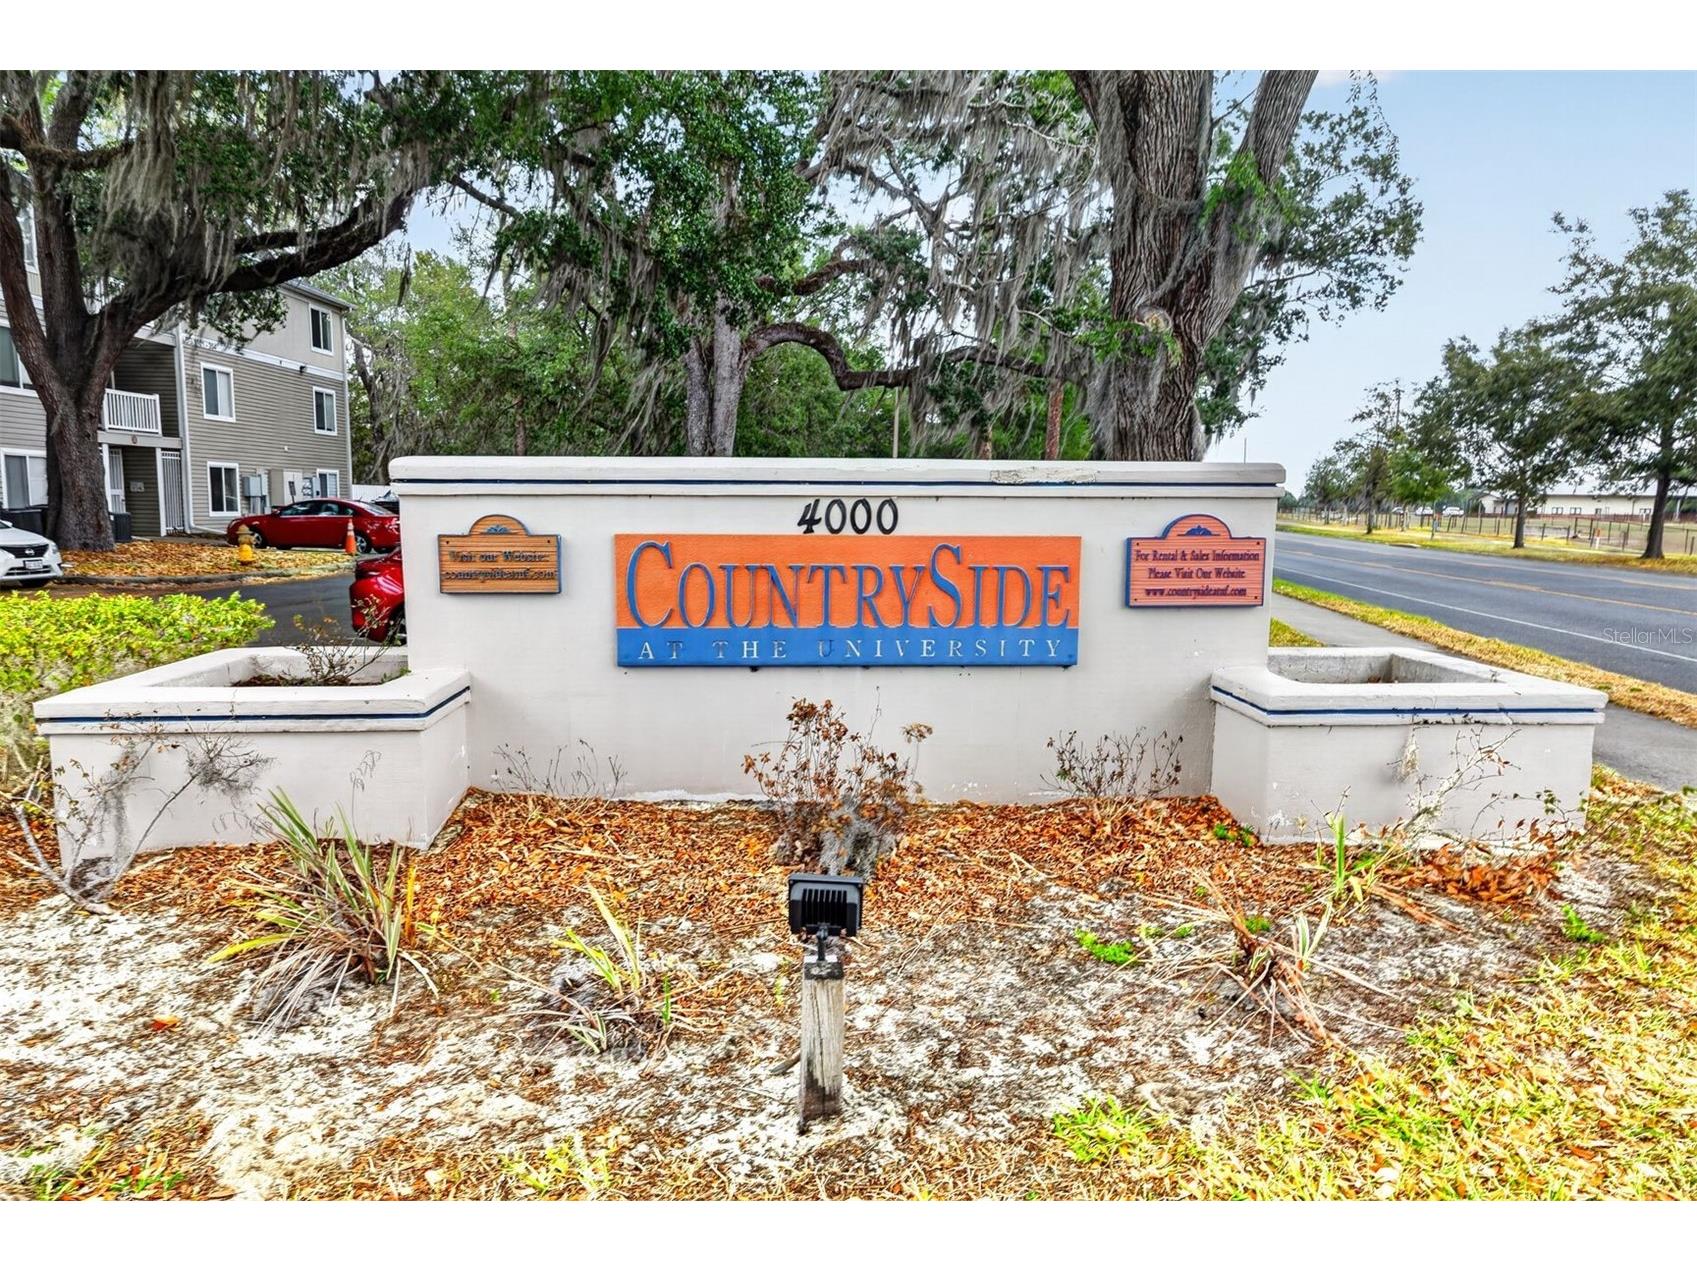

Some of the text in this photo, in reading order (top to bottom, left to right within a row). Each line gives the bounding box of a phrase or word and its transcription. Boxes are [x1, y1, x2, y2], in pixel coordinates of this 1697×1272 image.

[797, 498, 898, 535] 4000
[1135, 549, 1260, 561] For Rental & Sales Information
[1148, 568, 1172, 579] Please
[1174, 567, 1194, 579] Visit
[1195, 568, 1212, 579] Our
[638, 640, 1061, 660] AT THE UNIVERSITY
